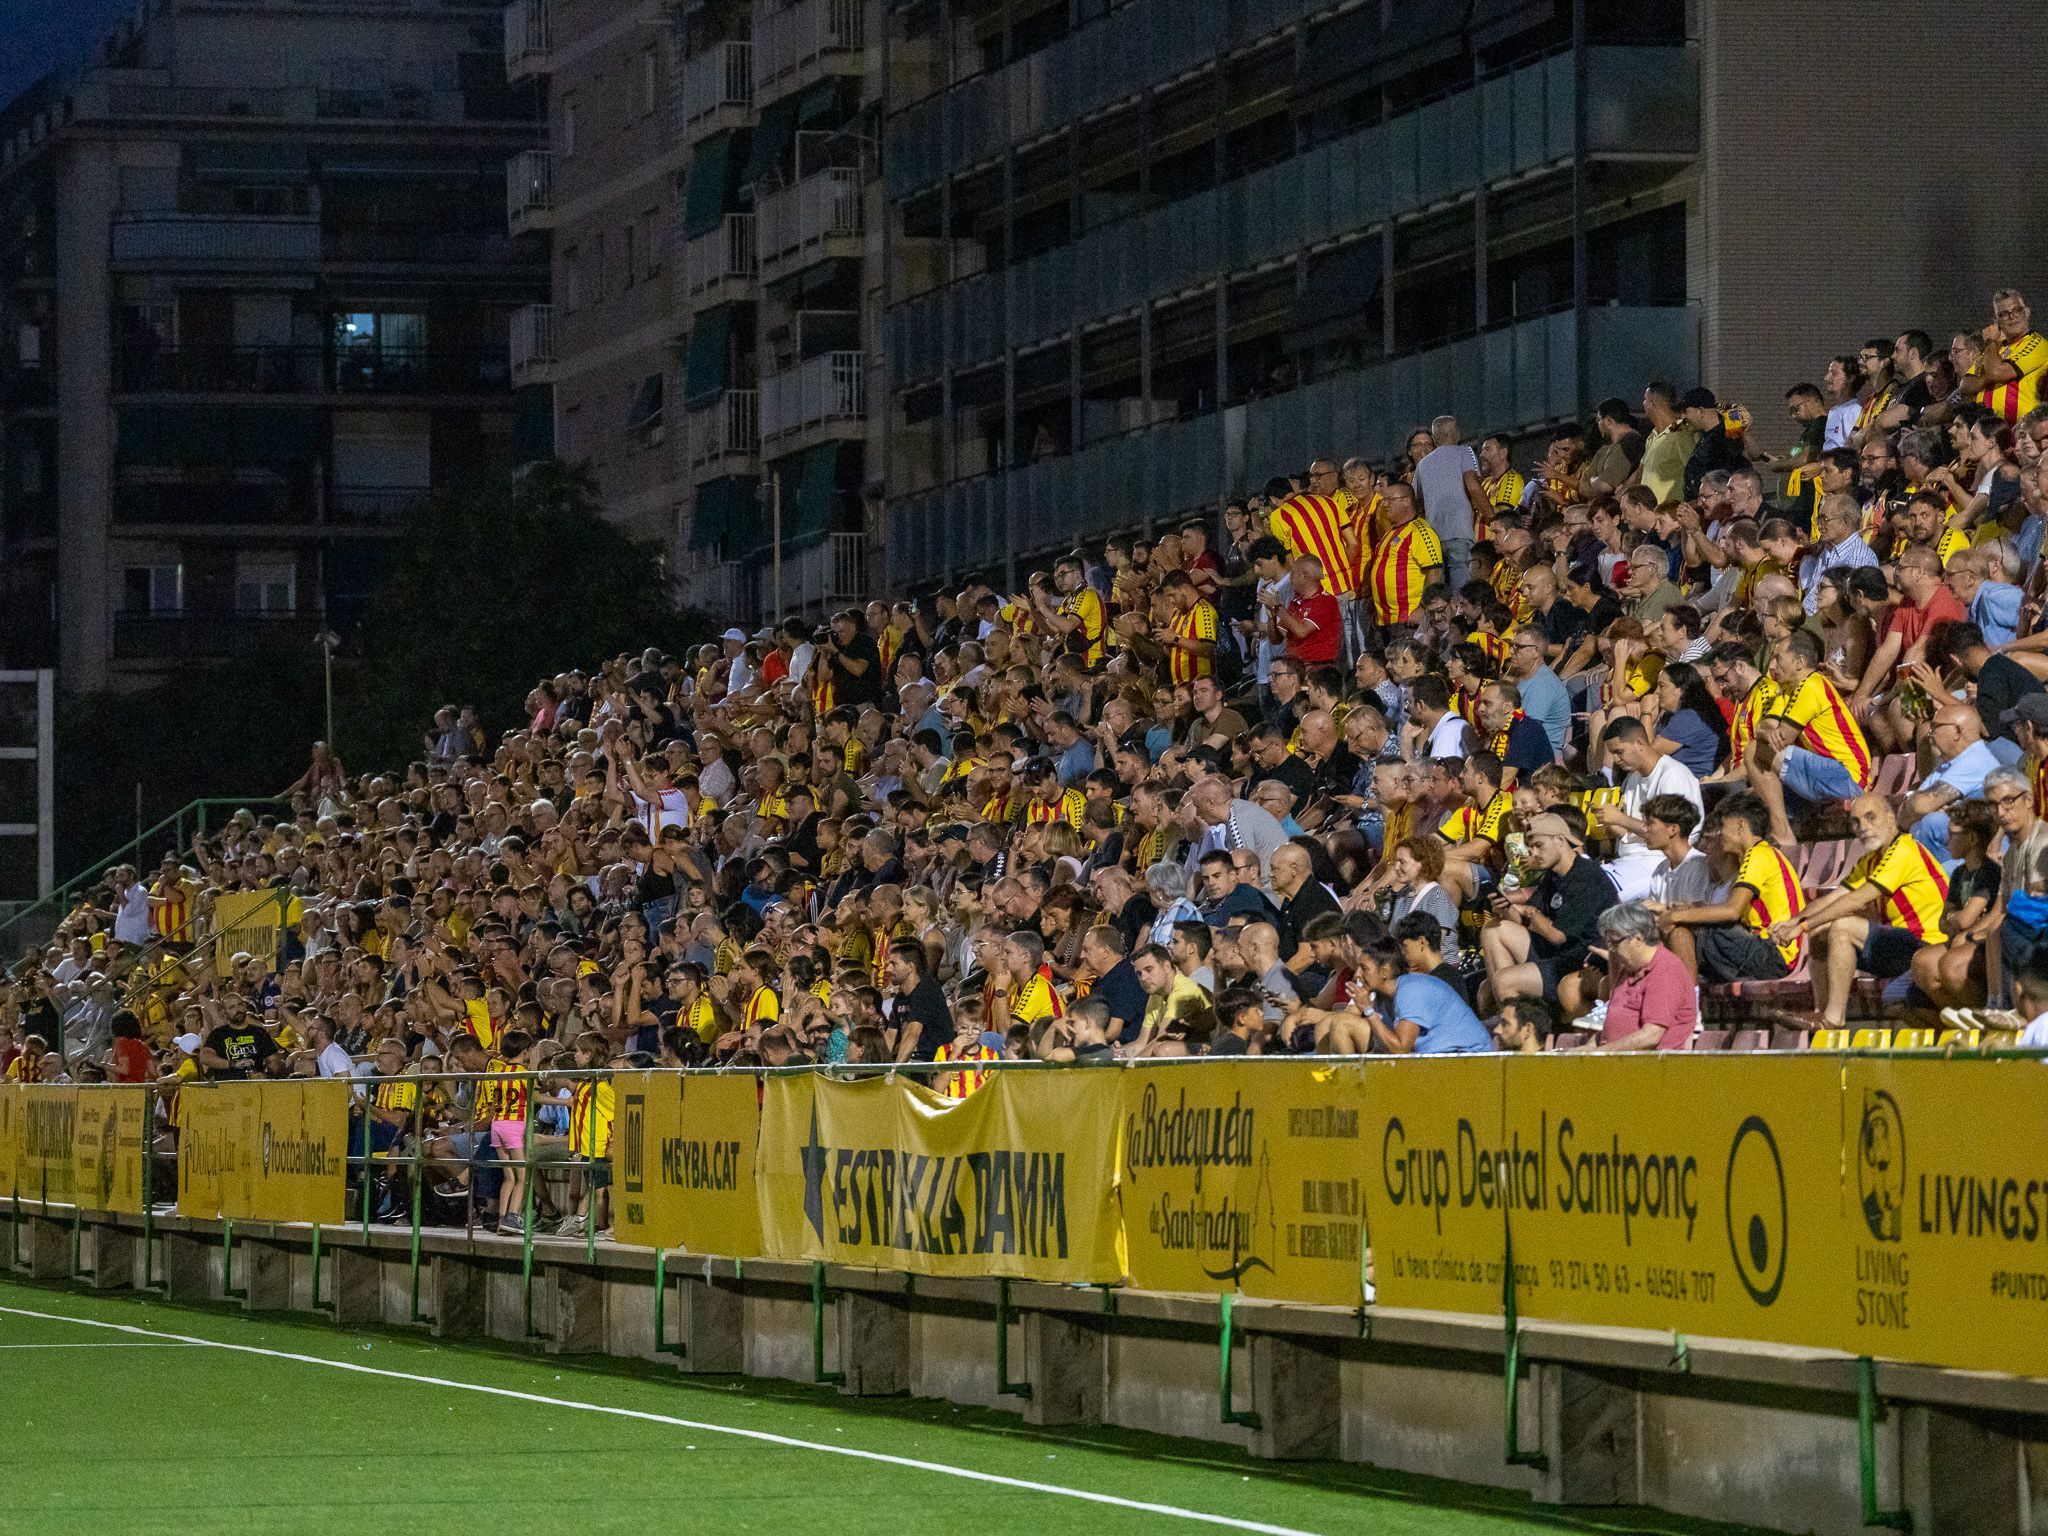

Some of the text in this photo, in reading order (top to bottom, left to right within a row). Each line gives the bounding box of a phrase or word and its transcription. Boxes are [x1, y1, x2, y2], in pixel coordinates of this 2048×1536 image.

[661, 1137, 740, 1191] MEYBA.CAT
[1383, 1109, 1699, 1248] Grup Dental Santponç
[967, 1149, 1069, 1259] DAMM
[1548, 1259, 1565, 1289] 93
[1593, 1262, 1611, 1293] 50
[1691, 1270, 1716, 1303] 707
[1855, 1244, 1910, 1287] LIVING
[1855, 1287, 1911, 1330] STONE
